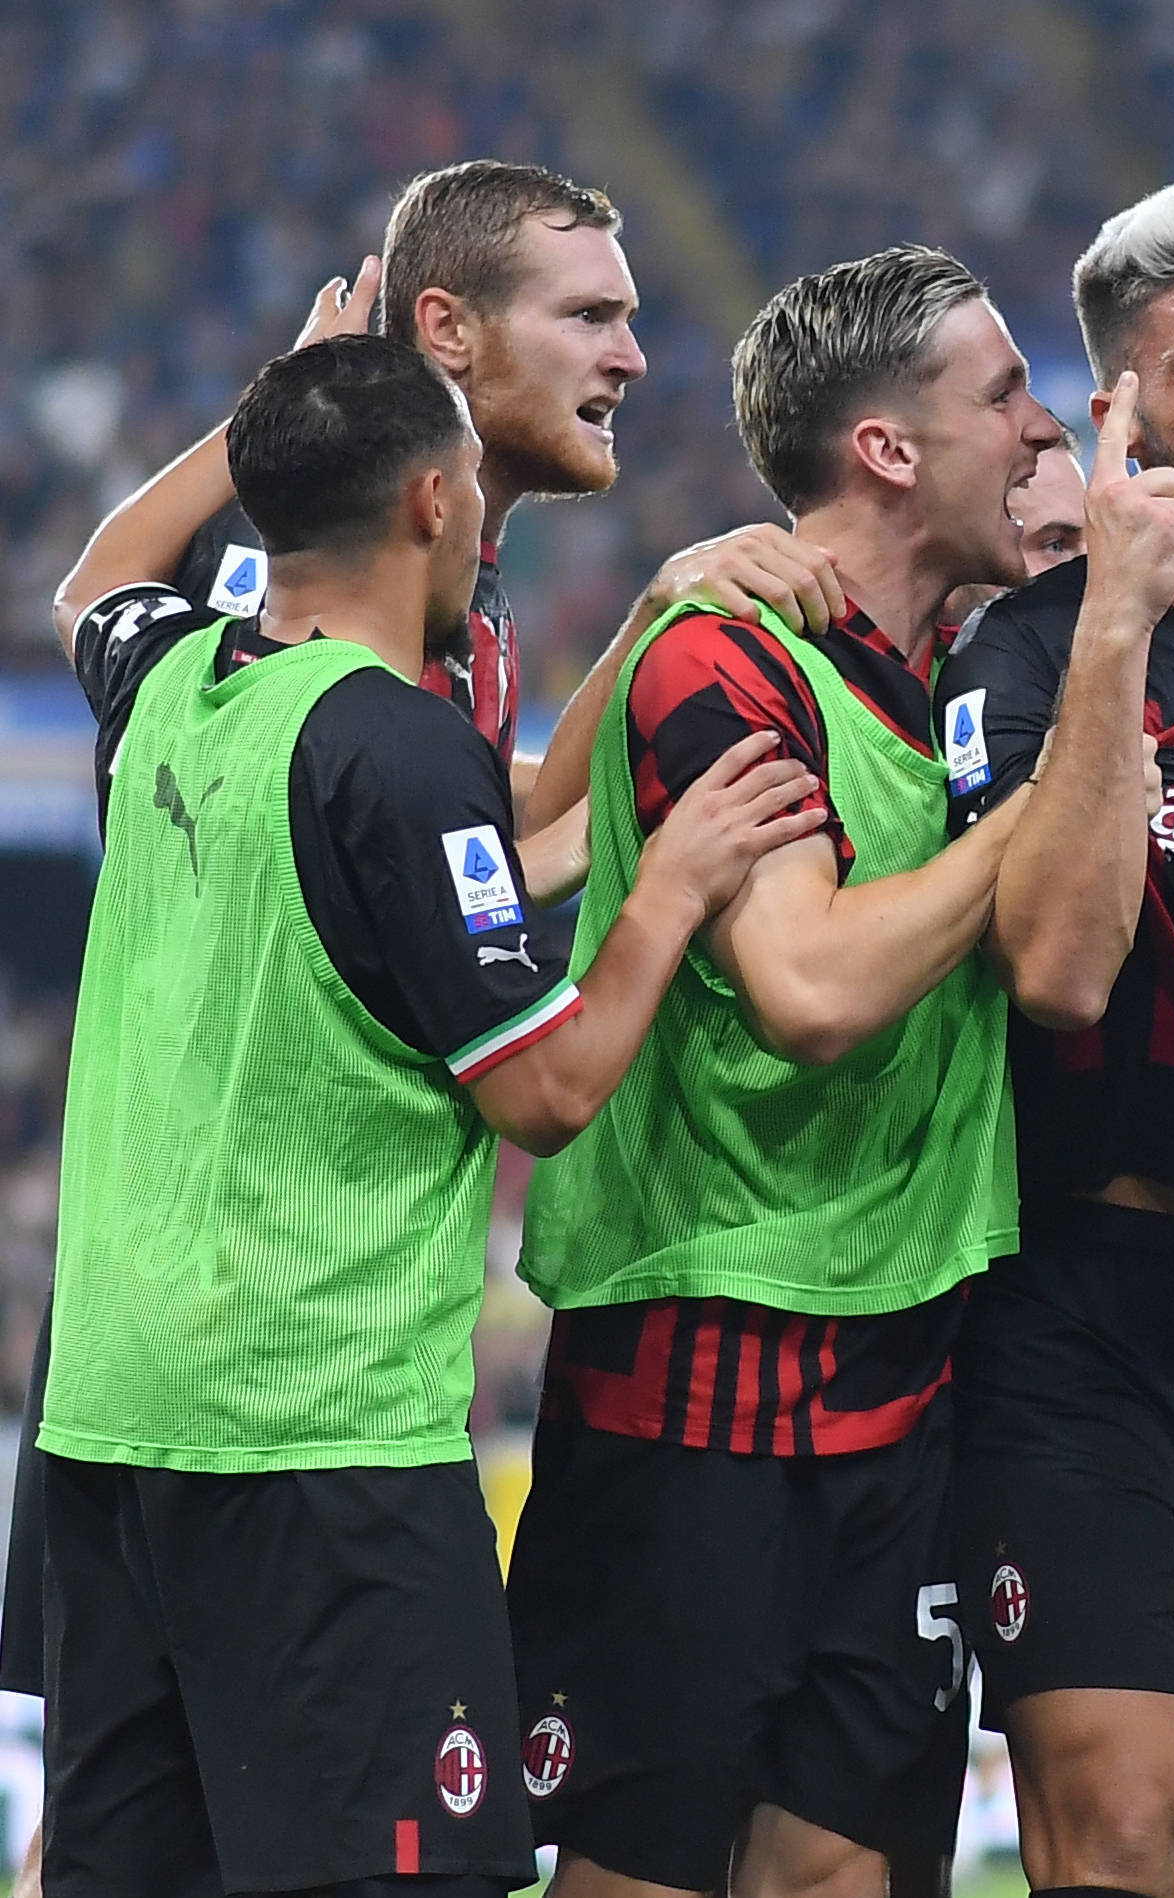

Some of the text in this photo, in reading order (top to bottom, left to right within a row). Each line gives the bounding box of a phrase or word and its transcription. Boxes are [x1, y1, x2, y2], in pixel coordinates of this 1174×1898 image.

[953, 751, 973, 767] SERIE
[966, 768, 986, 787] TIM
[467, 886, 508, 902] SERIE A
[488, 907, 516, 925] TIM
[917, 1582, 963, 1712] 5
[537, 1719, 566, 1738] ACM
[446, 1733, 474, 1749] ACM
[527, 1777, 552, 1790] 1899
[450, 1796, 473, 1806] 1899
